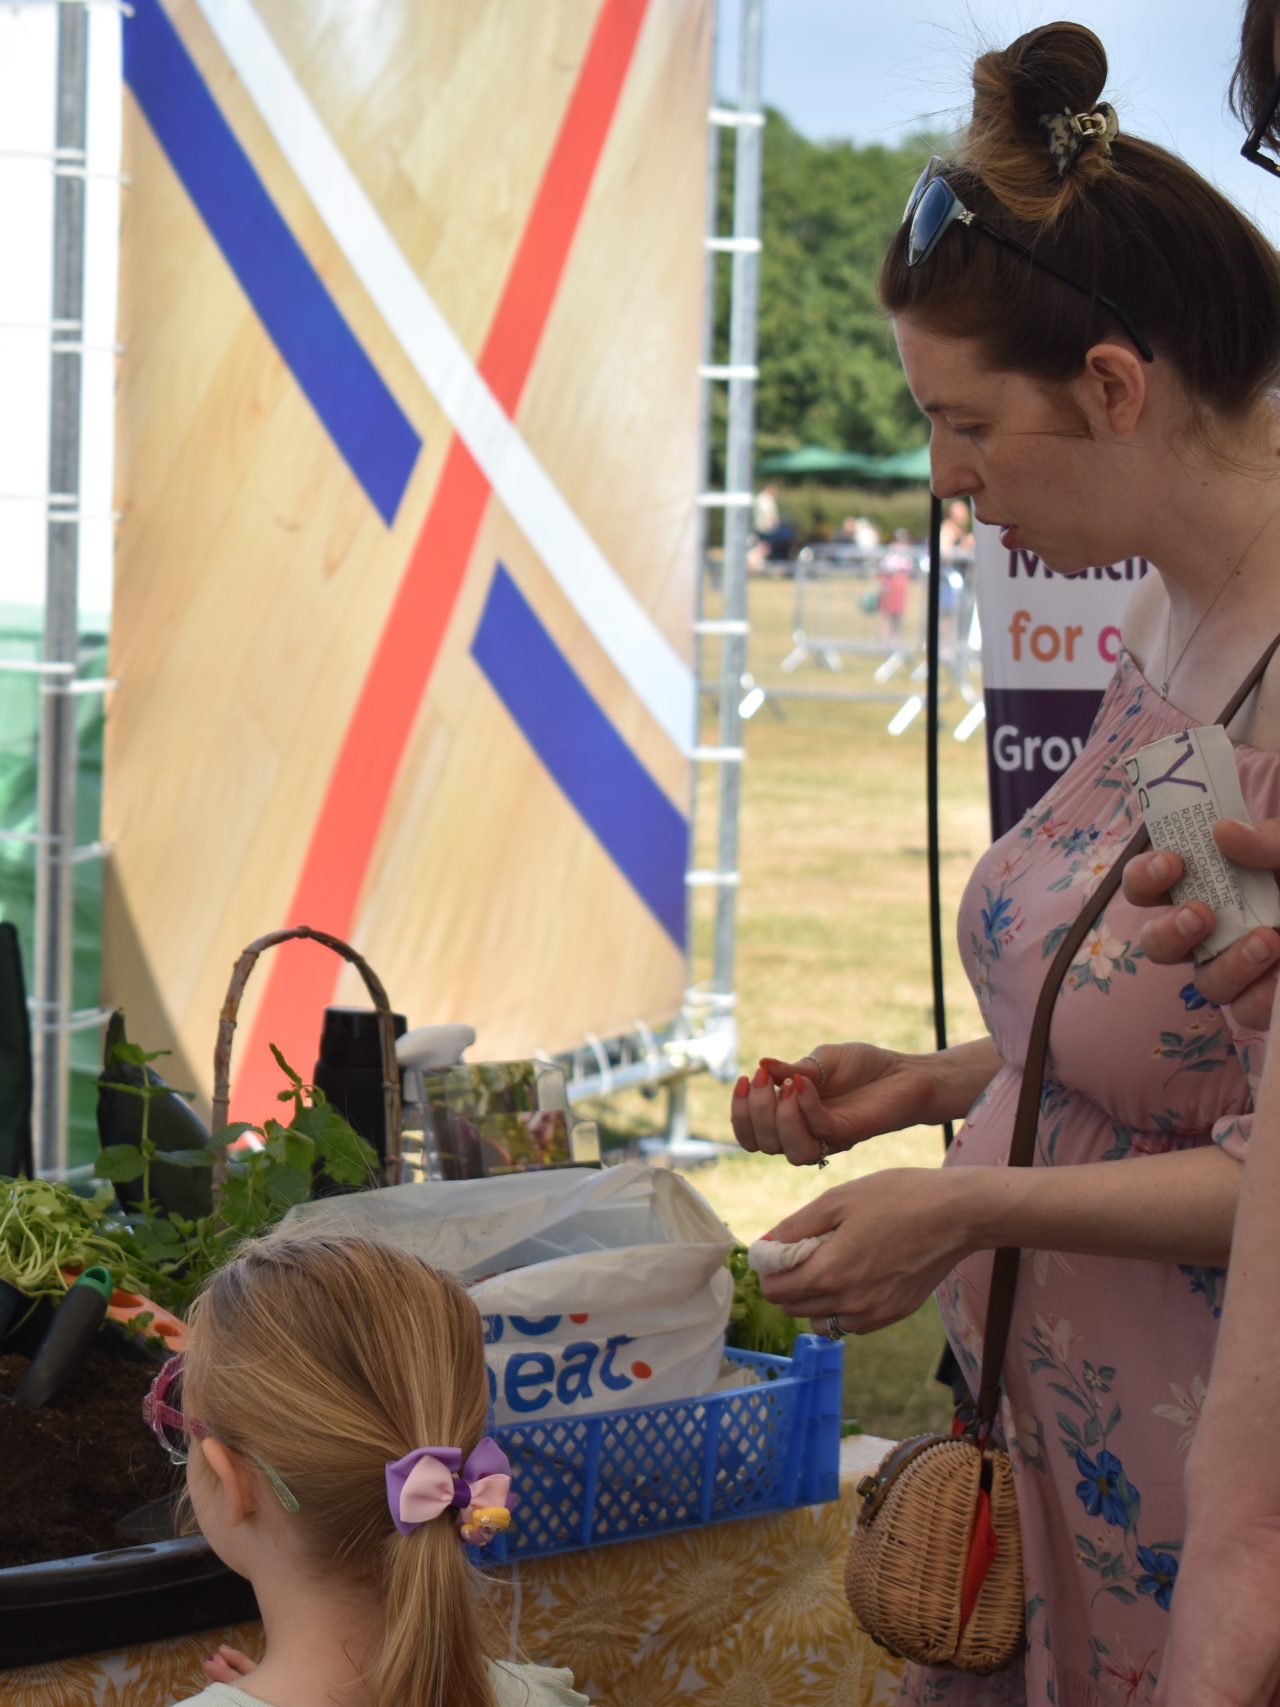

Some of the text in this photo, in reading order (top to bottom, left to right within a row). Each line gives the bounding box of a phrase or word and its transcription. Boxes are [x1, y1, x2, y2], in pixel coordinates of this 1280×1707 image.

[1008, 610, 1083, 662] for
[1170, 811, 1190, 848] GOING
[1183, 849, 1201, 881] FROM
[1180, 807, 1203, 853] RAILWAY
[1191, 803, 1221, 866] RETURNING
[1213, 867, 1226, 884] TO
[1220, 884, 1234, 908] THE
